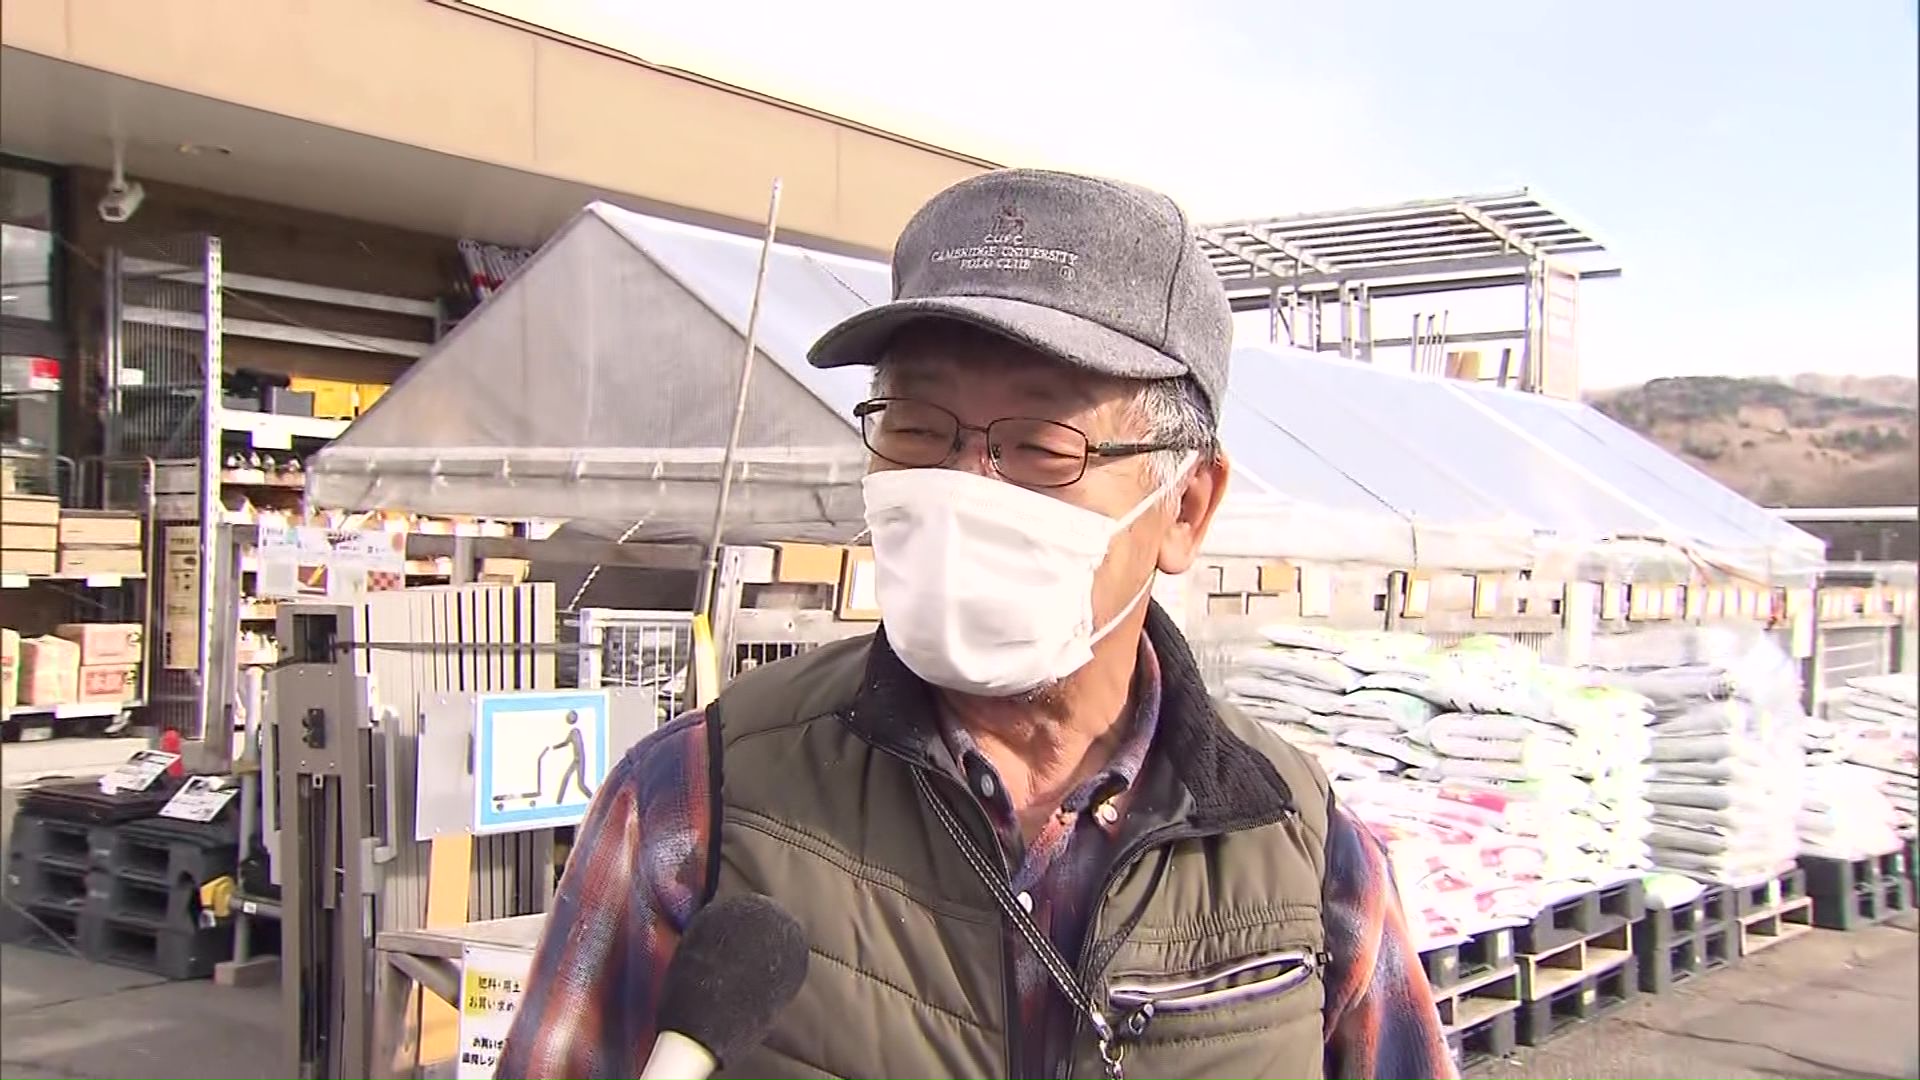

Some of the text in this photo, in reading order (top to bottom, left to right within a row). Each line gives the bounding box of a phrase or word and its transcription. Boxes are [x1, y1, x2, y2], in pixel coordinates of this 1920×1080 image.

[931, 246, 1079, 265] CAMBRIDGE UNIVERSITY
[960, 258, 1031, 270] POLO CLUB
